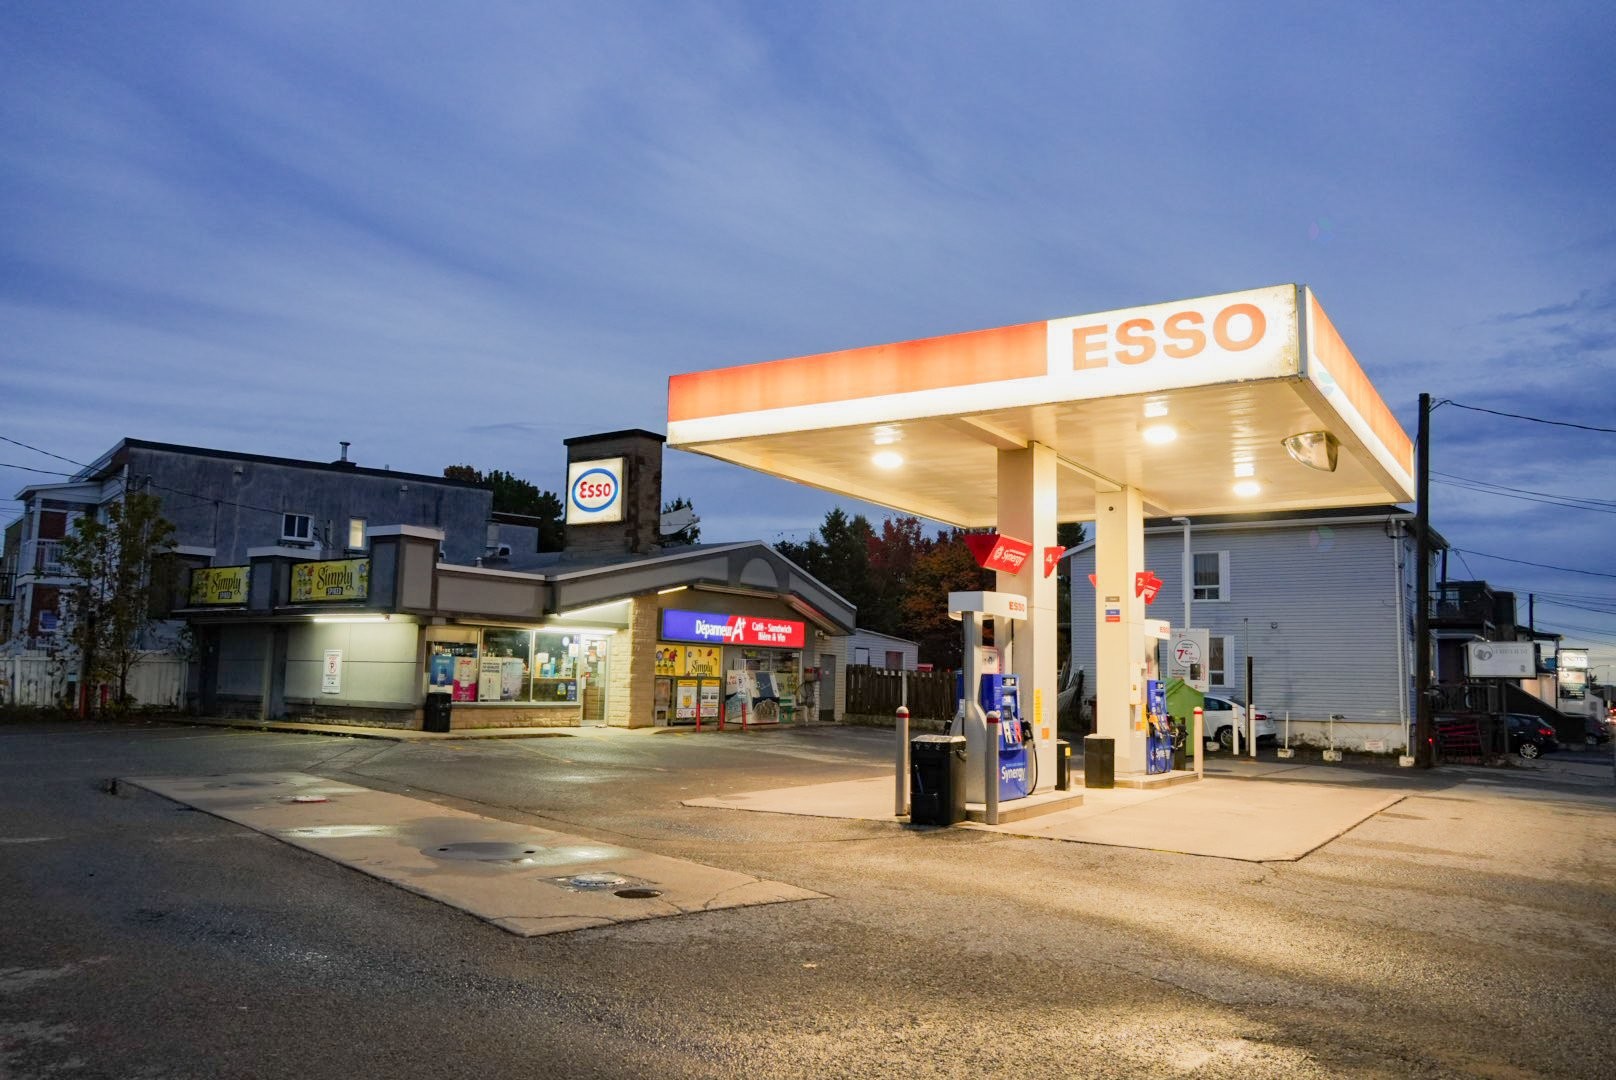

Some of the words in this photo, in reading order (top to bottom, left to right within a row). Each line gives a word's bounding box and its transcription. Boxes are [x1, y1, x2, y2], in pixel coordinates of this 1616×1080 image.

[1072, 303, 1267, 371] ESSO
[1002, 549, 1025, 567] Synergy
[1045, 553, 1053, 564] 4
[211, 570, 241, 594] Simply
[317, 564, 354, 590] Simply
[1137, 577, 1144, 587] 2
[695, 619, 733, 639] Dépanneur
[751, 621, 765, 632] Café
[767, 623, 792, 634] Sandwich
[691, 660, 713, 676] Simply
[1001, 766, 1026, 783] Synergy
